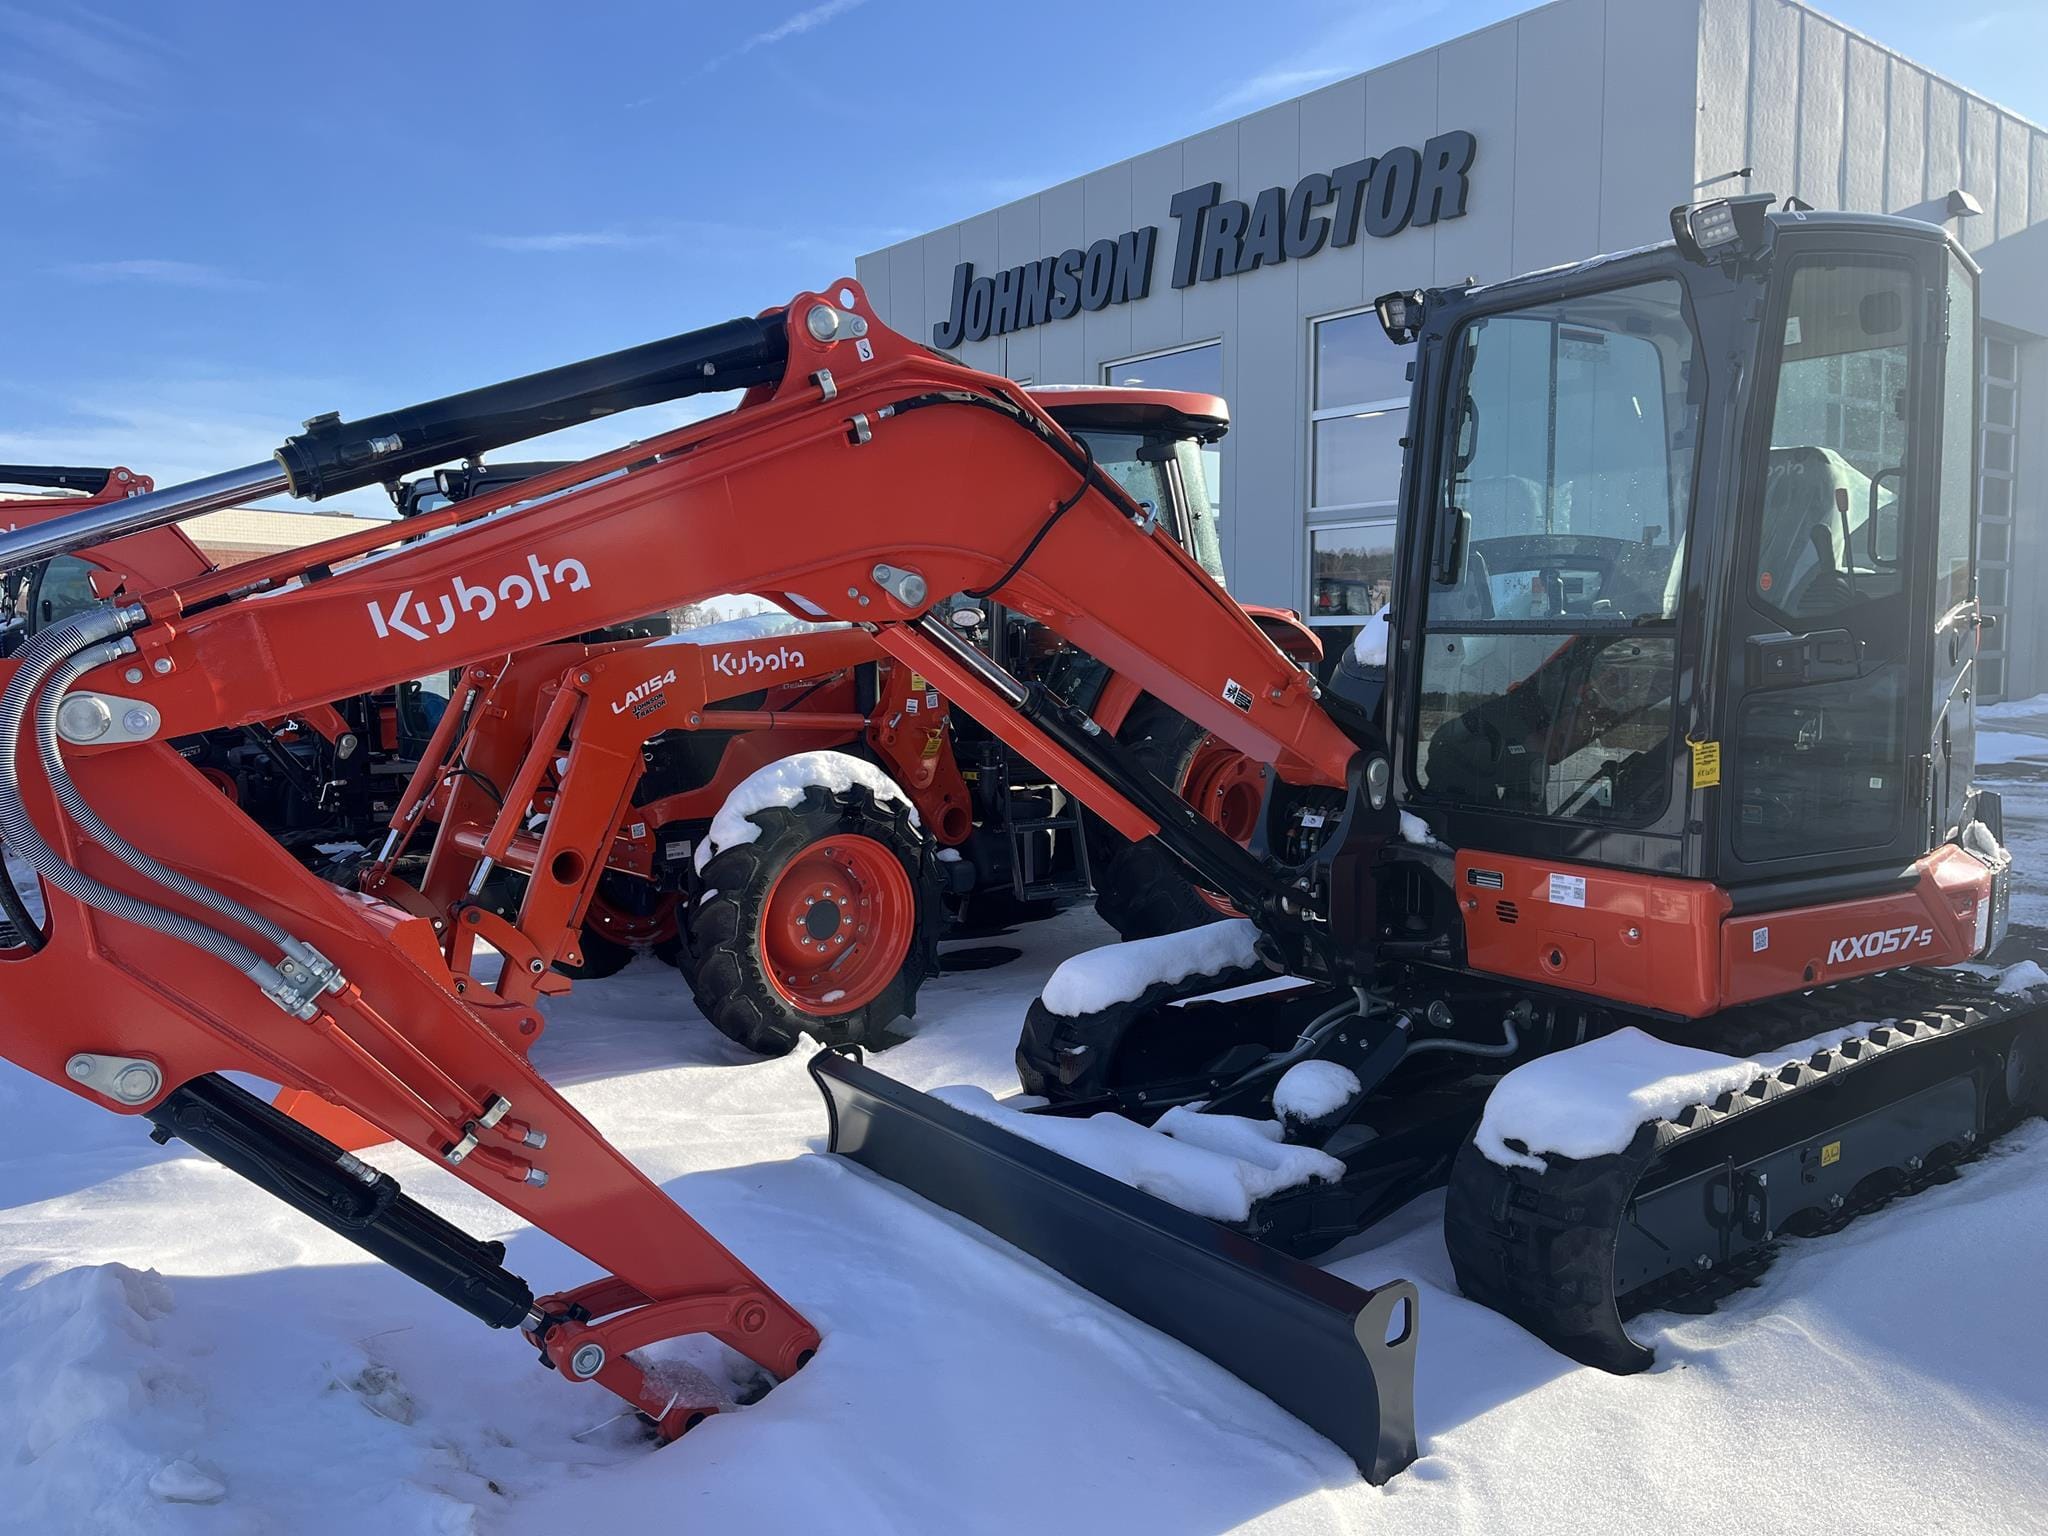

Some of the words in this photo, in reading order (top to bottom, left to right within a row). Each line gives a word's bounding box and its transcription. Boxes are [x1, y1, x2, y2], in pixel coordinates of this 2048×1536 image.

[933, 225, 1158, 350] JOHNSON
[1169, 129, 1477, 290] TRACTOR
[366, 553, 591, 642] Kubota
[712, 646, 805, 676] Kubota
[611, 669, 677, 715] LA1154
[632, 691, 664, 714] JOHNSON
[635, 699, 667, 720] TRACTOR
